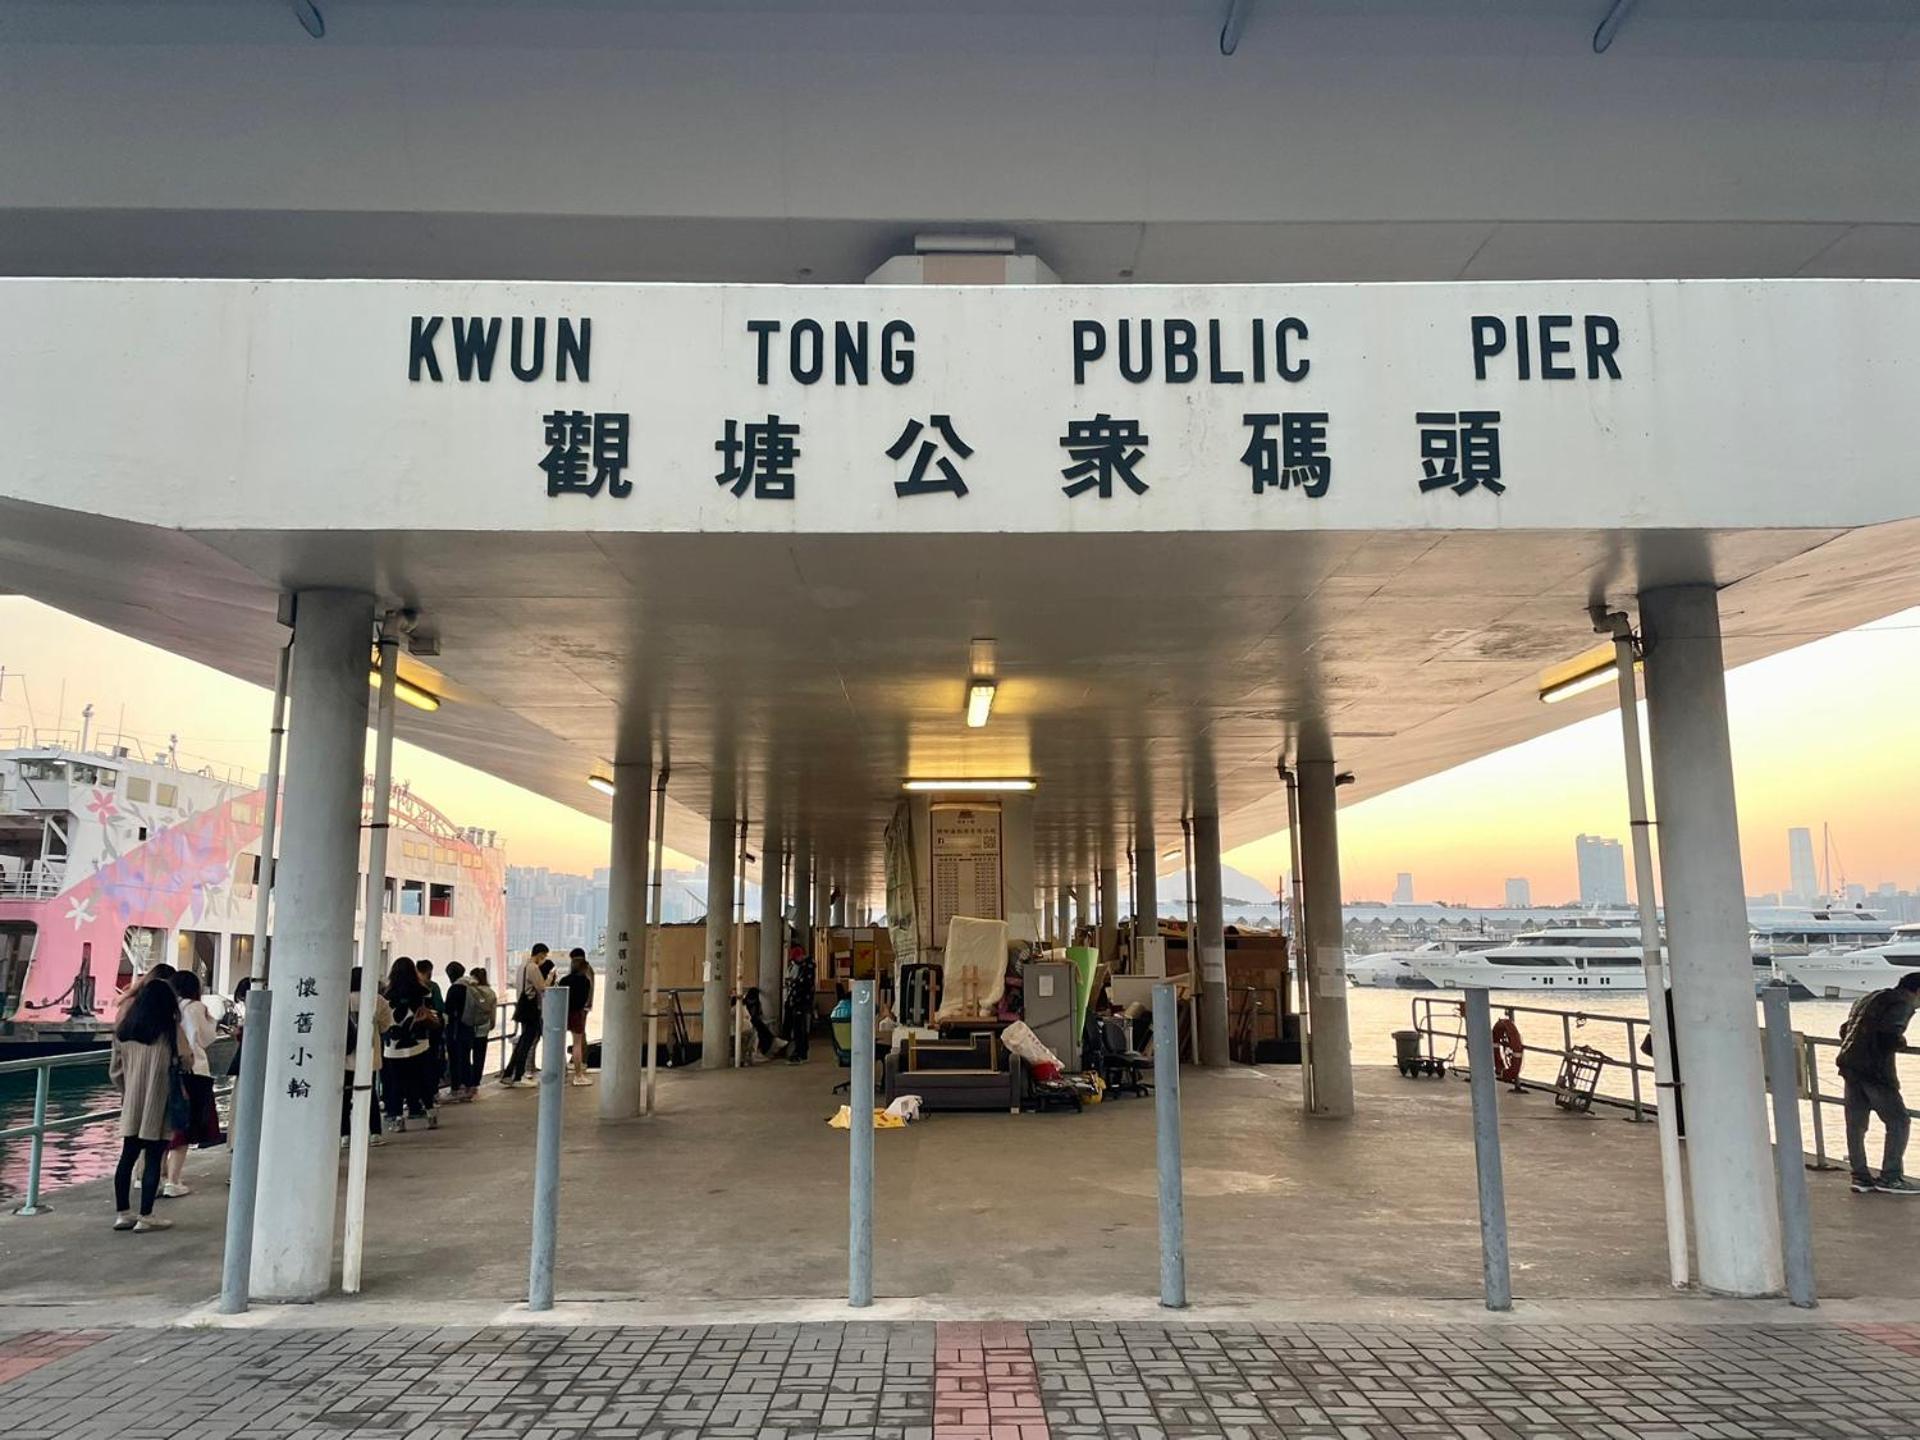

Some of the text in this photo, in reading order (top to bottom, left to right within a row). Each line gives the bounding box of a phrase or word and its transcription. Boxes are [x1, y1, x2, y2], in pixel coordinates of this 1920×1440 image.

[408, 316, 1622, 386] KWUN TONG PUBLIC PIER
[286, 977, 320, 1099] 懷舊小輪
